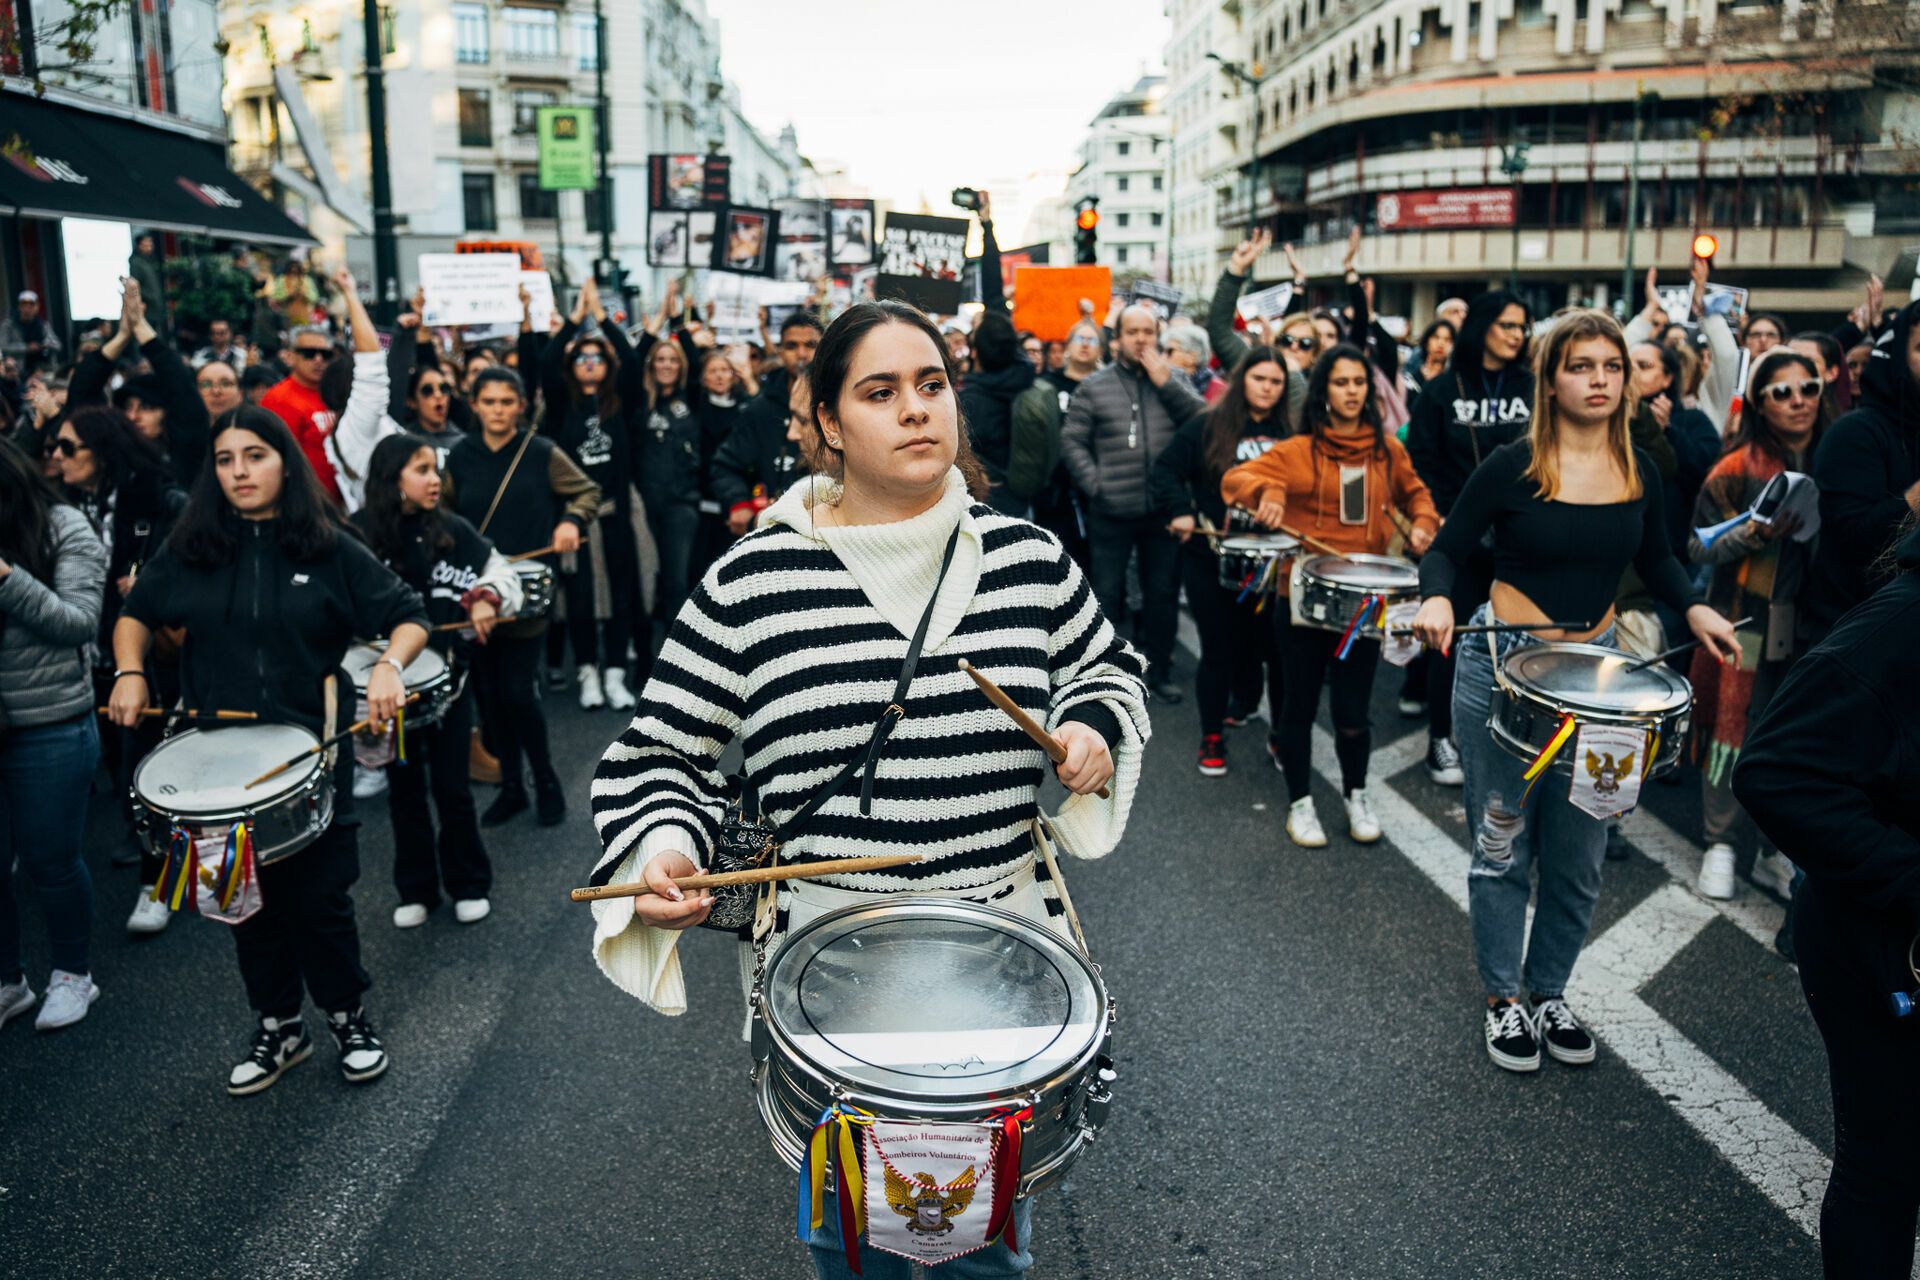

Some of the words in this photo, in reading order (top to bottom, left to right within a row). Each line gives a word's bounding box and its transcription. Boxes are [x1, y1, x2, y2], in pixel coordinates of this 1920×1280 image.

[878, 1133, 919, 1143] ssociação
[920, 1132, 972, 1142] Humanitária
[974, 1136, 985, 1144] de
[929, 1150, 977, 1161] Voluntários
